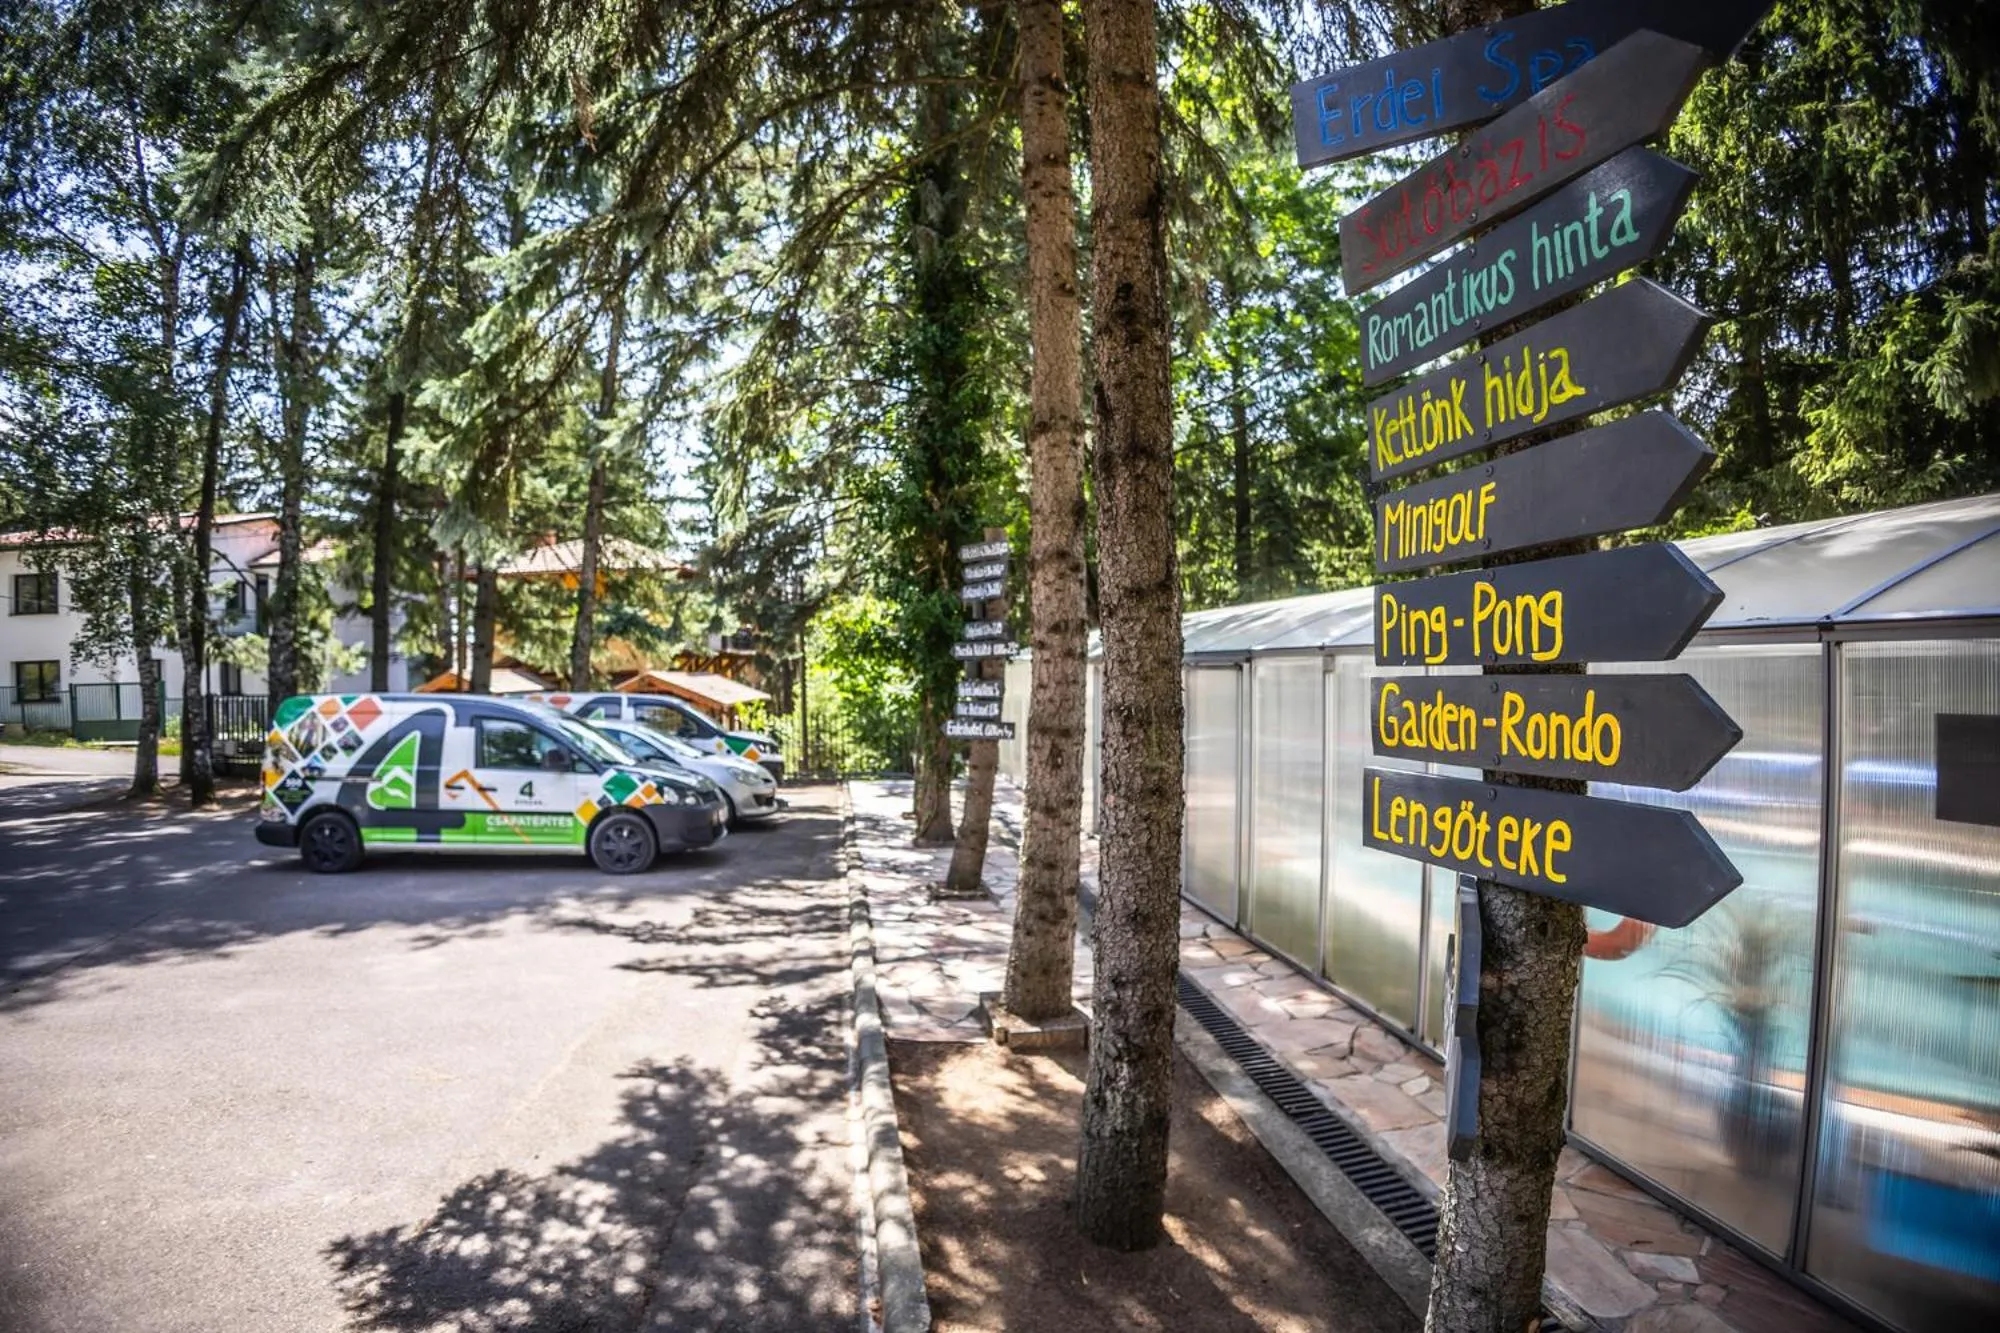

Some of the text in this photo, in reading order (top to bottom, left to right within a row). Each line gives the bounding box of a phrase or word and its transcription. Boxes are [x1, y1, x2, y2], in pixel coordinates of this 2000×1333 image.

[1316, 67, 1444, 146] Erdei
[1368, 188, 1640, 370] Romantikus hinta
[1484, 346, 1587, 429] hidja
[519, 780, 537, 798] 4
